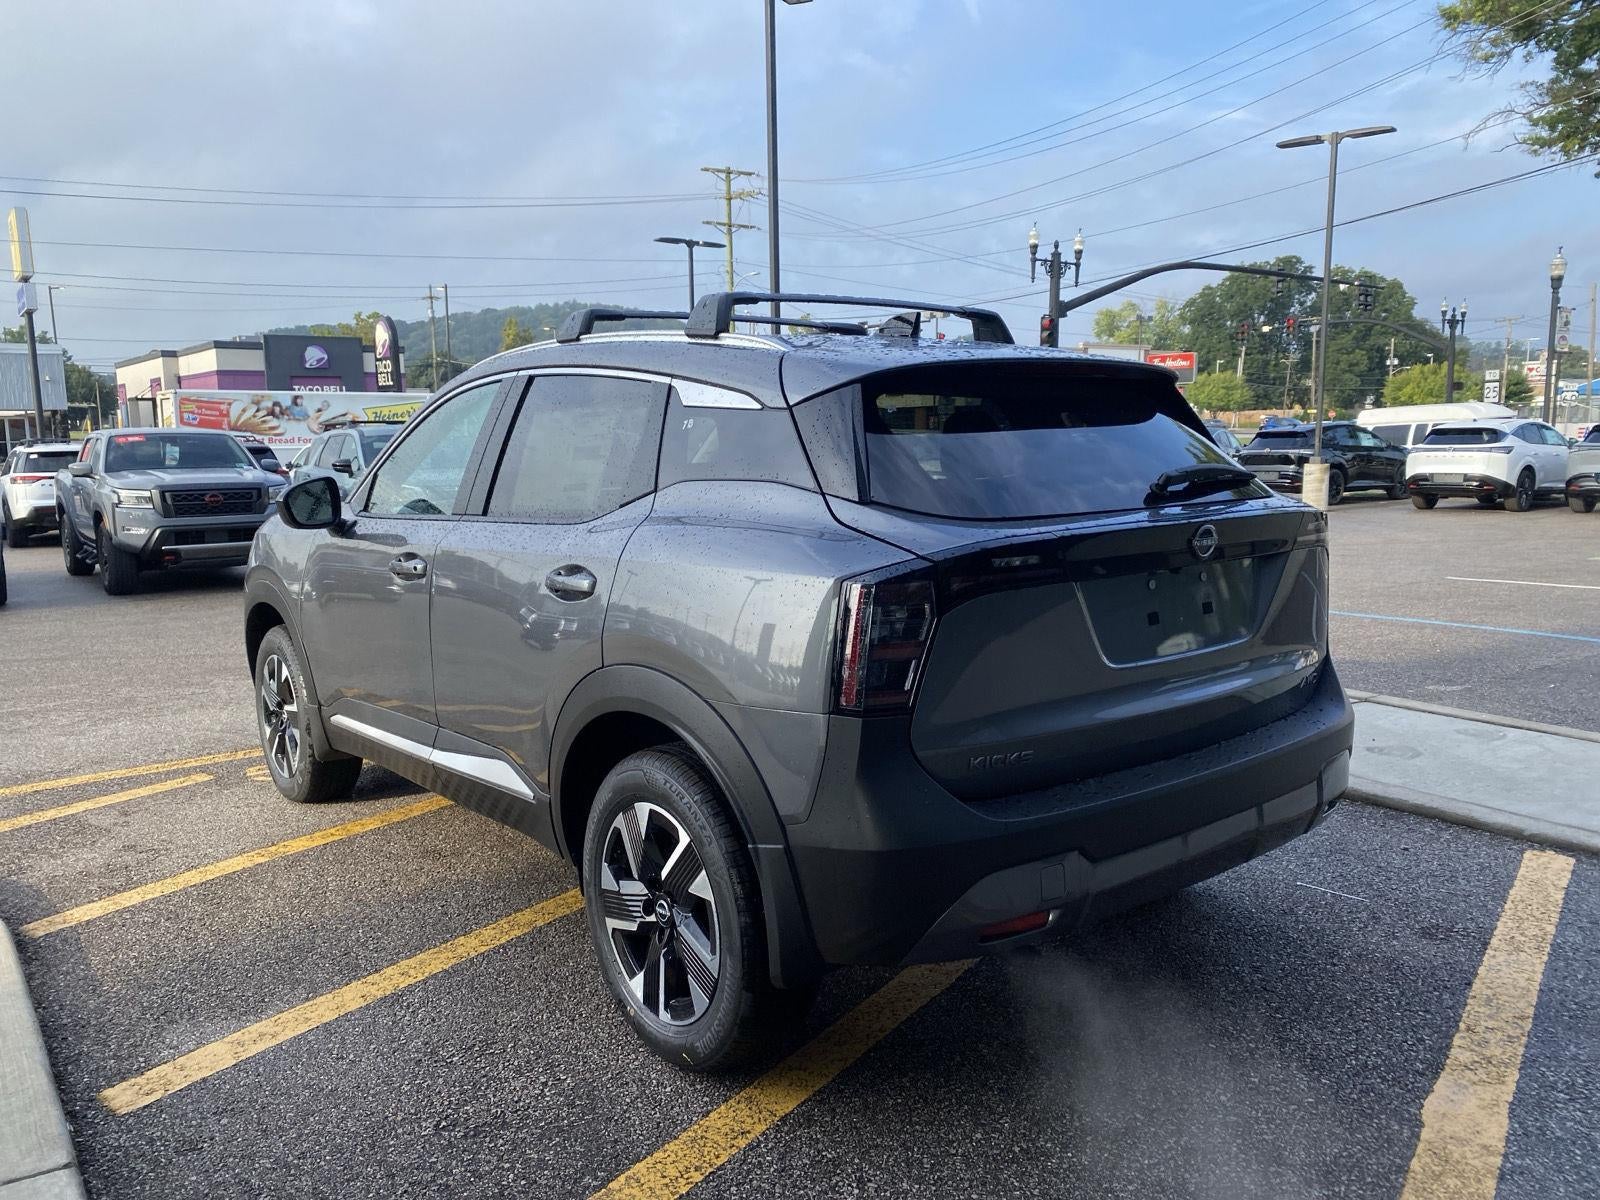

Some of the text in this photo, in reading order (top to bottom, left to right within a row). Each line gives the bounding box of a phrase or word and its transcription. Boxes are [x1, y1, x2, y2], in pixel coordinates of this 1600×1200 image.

[376, 360, 392, 372] TACO
[1164, 357, 1190, 367] Hortons
[377, 373, 394, 386] BELL
[1484, 386, 1499, 399] 25
[372, 405, 418, 421] Heiner'
[267, 436, 295, 444] Bread
[969, 750, 1034, 769] KICKS
[663, 779, 713, 847] TURANZA
